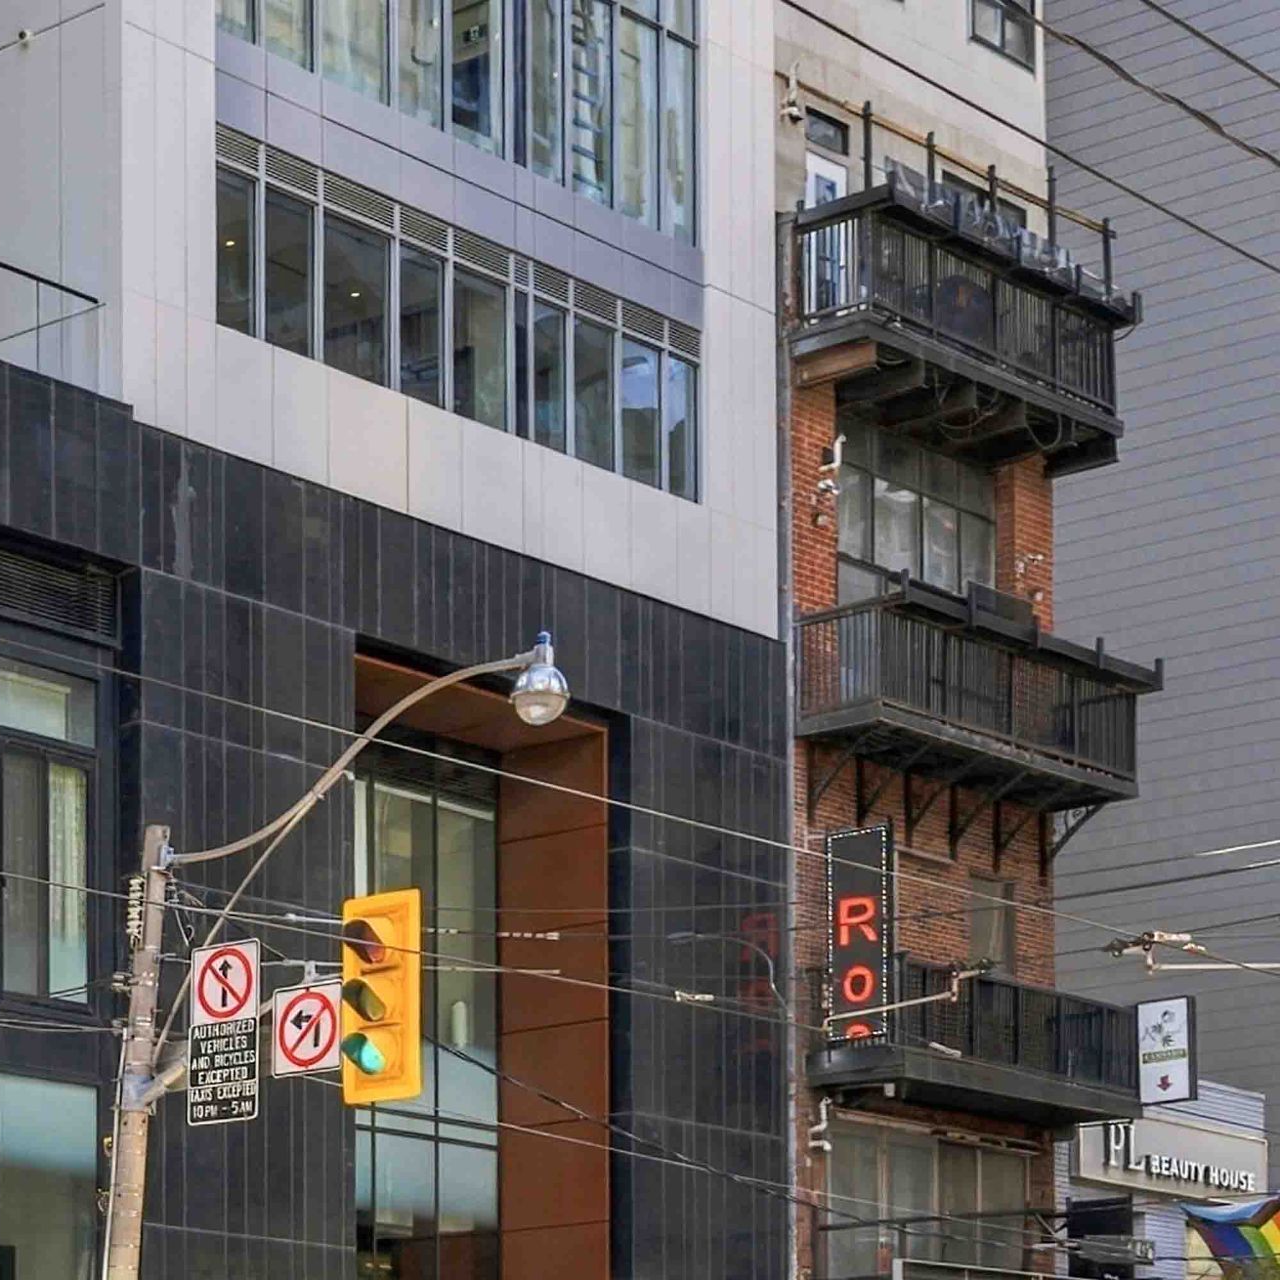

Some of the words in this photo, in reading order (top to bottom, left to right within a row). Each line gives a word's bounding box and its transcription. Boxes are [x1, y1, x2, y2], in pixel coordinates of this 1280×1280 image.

[193, 1019, 254, 1039] AUTHORIZED
[200, 1036, 247, 1054] VEHICLES
[192, 1057, 210, 1070] AND
[214, 1050, 256, 1067] BICYCLES
[198, 1066, 248, 1084] EXCEPTED
[190, 1088, 213, 1102] TAXIS
[217, 1082, 256, 1099] EXCEPTED
[1109, 1124, 1145, 1170] PL
[1151, 1154, 1205, 1182] BEAUTY
[1209, 1165, 1255, 1191] HOUSE
